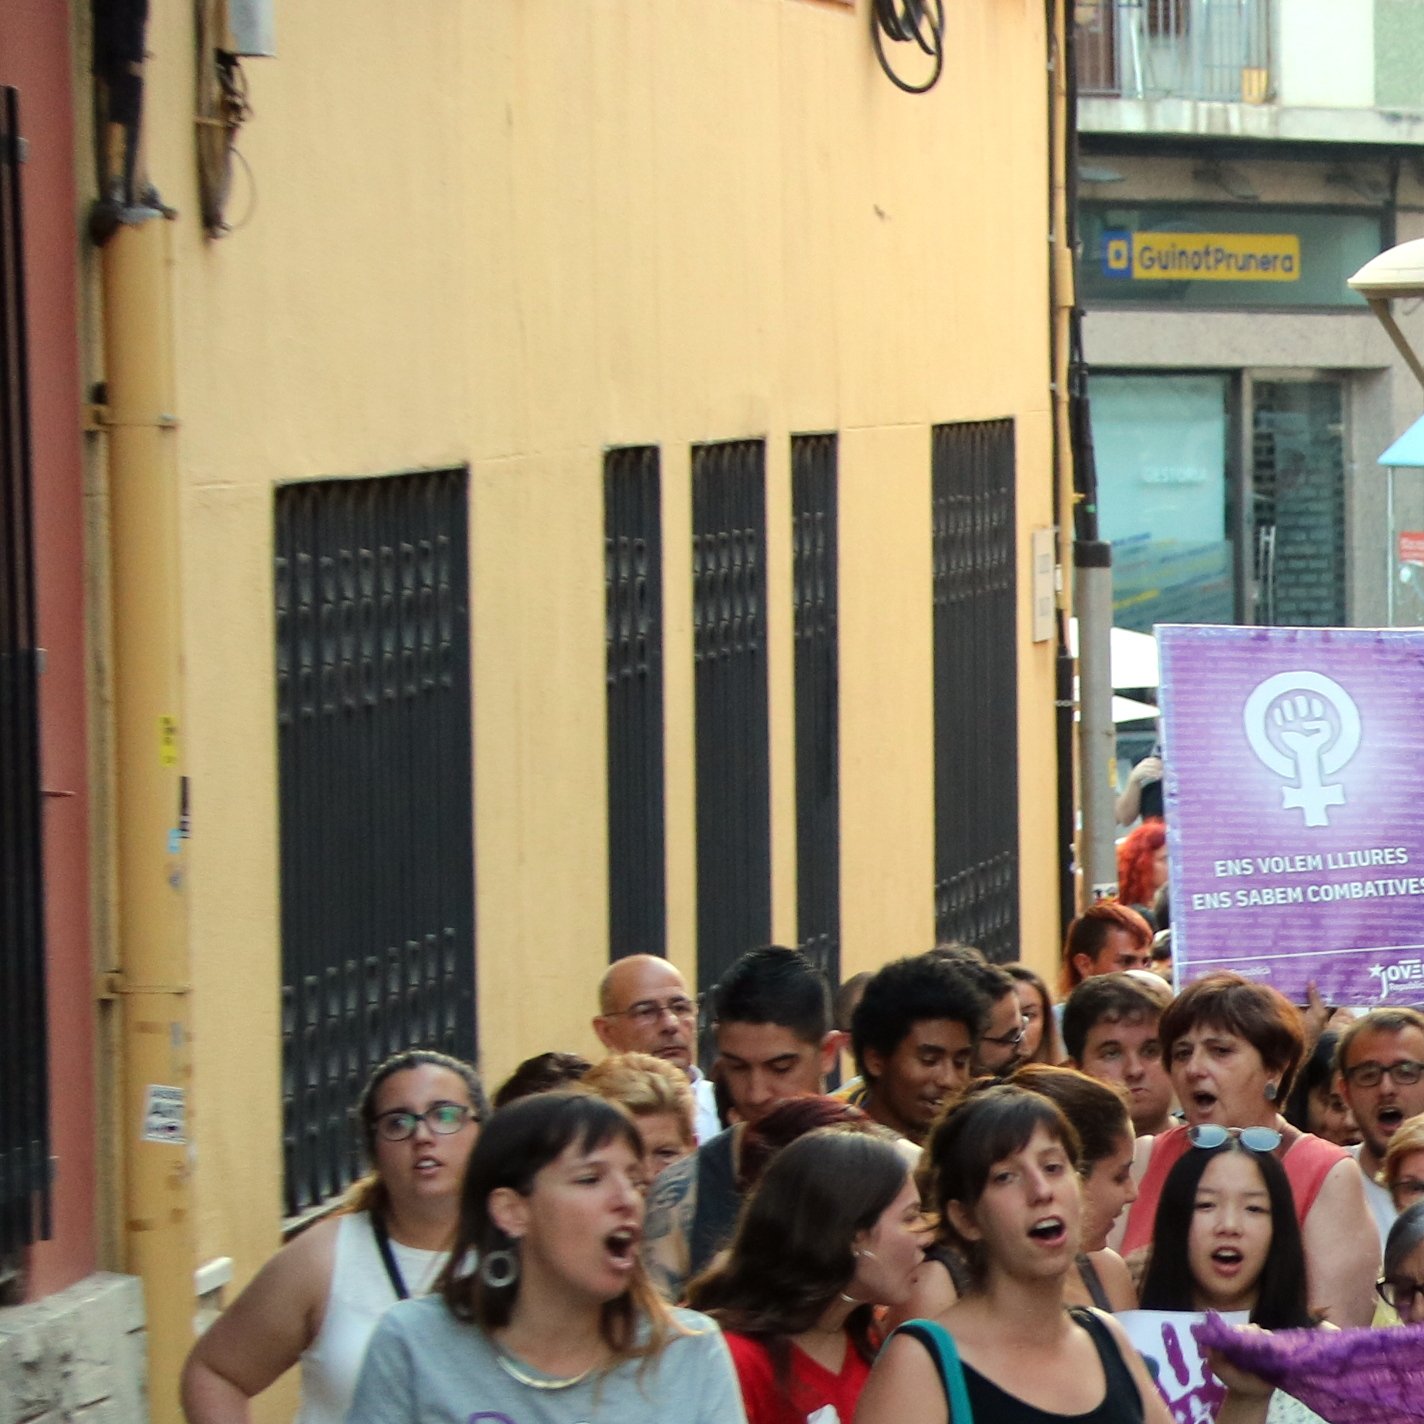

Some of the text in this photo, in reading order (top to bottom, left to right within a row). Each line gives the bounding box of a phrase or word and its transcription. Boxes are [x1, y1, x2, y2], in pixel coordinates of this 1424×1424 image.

[1140, 244, 1294, 274] GuinotPrunera
[1215, 847, 1409, 878] ENS VOLEM LLIURES
[1192, 891, 1232, 911] ENS
[1237, 886, 1304, 908] SABEM
